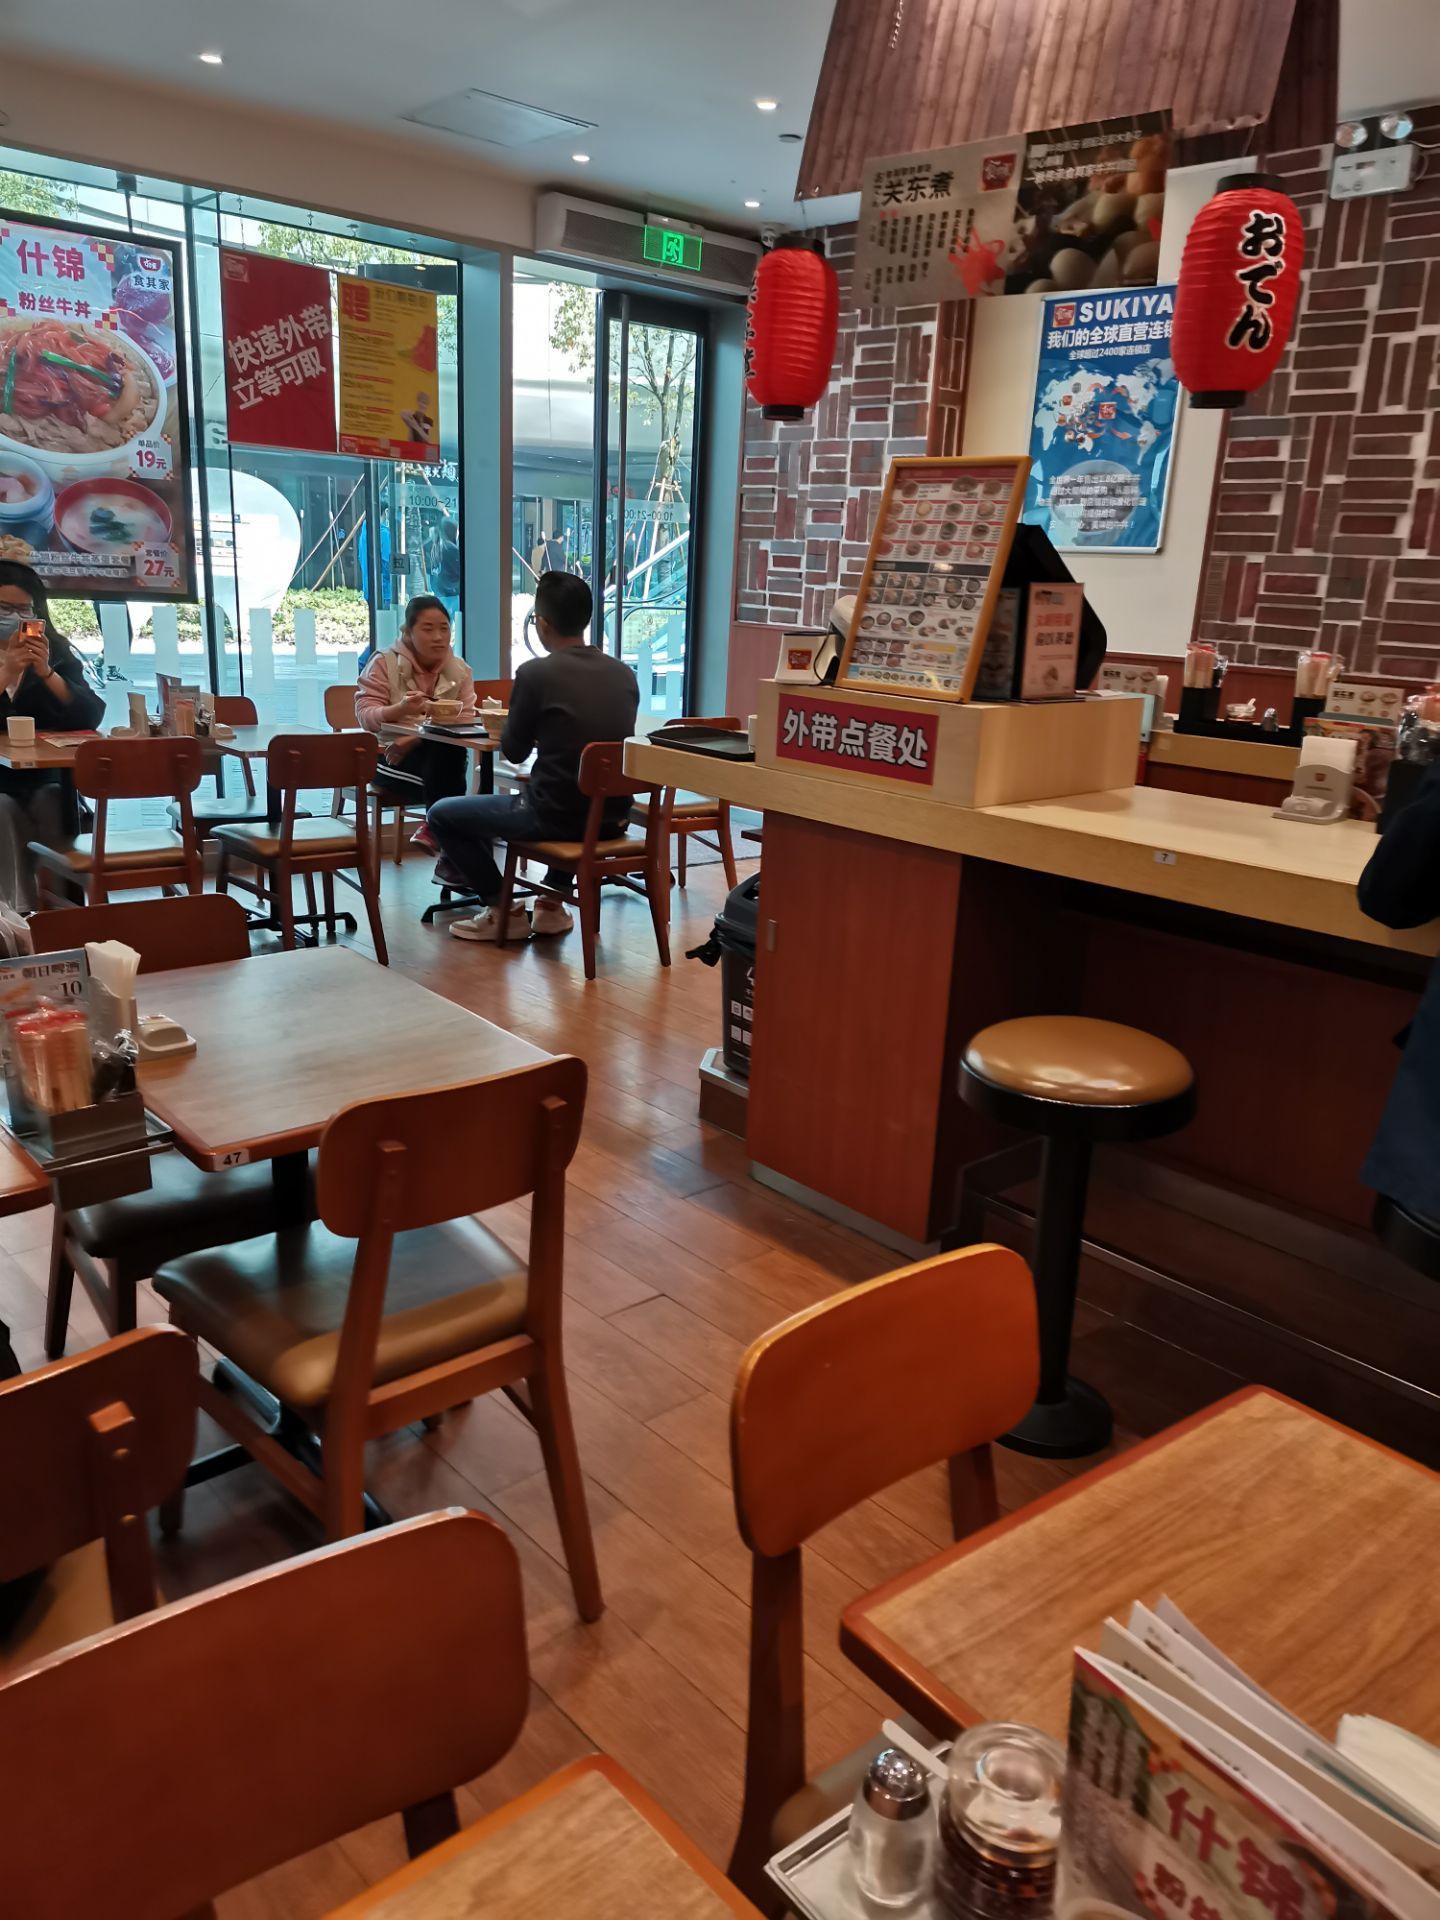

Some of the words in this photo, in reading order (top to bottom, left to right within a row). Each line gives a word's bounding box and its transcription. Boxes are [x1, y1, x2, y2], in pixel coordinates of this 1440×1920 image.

[881, 170, 954, 206] 关东煮
[16, 239, 86, 282] 什锦
[133, 275, 170, 291] 食其家
[1225, 209, 1287, 352] おでん
[18, 291, 92, 319] 粉丝牛丼
[1079, 293, 1173, 323] SUKIYA
[227, 303, 331, 374] 快速外带
[232, 346, 327, 411] 立等可取
[136, 449, 167, 470] 19元
[143, 559, 175, 578] 27元
[783, 708, 928, 769] 外带点餐处
[22, 961, 80, 979] 朝日啤酒
[61, 980, 82, 997] 10
[222, 1151, 242, 1166] 47
